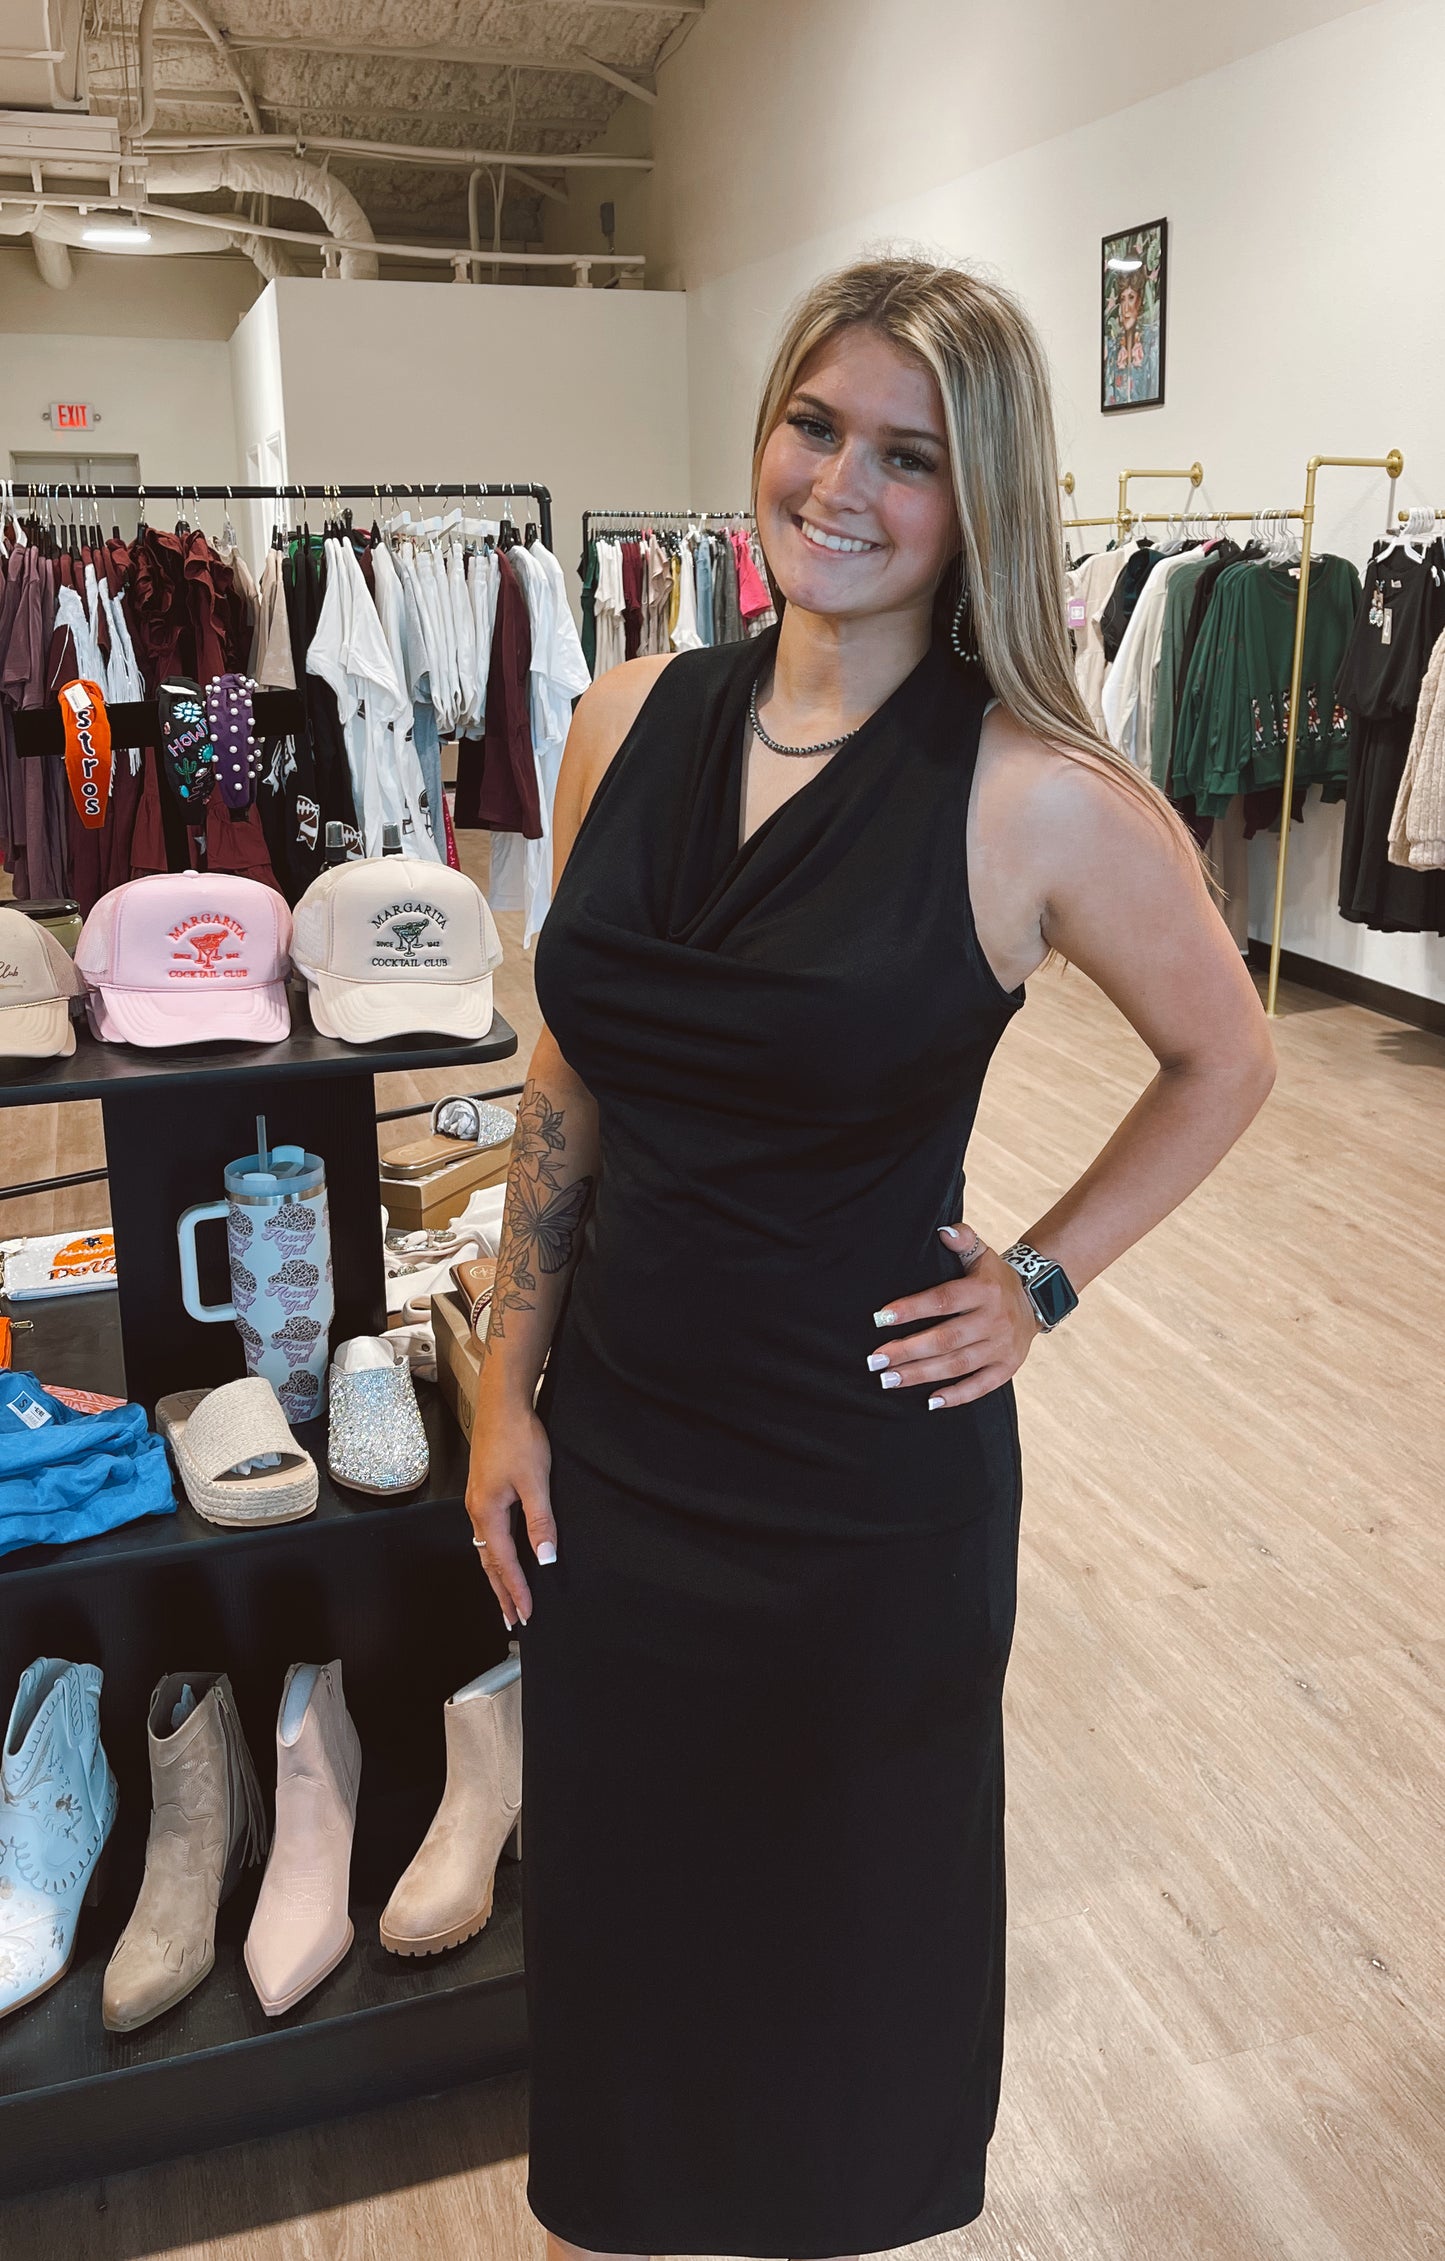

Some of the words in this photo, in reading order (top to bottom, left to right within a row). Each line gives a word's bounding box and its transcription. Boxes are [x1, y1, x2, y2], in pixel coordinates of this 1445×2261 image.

[58, 404, 87, 427] EXIT
[76, 704, 101, 815] stros
[168, 913, 247, 941] MARGARITA
[371, 902, 447, 929] MARGARITA
[168, 969, 220, 978] COCKTAIL
[223, 968, 248, 978] CLUB
[371, 957, 420, 967] COCKTAIL
[423, 958, 448, 967] CLUB
